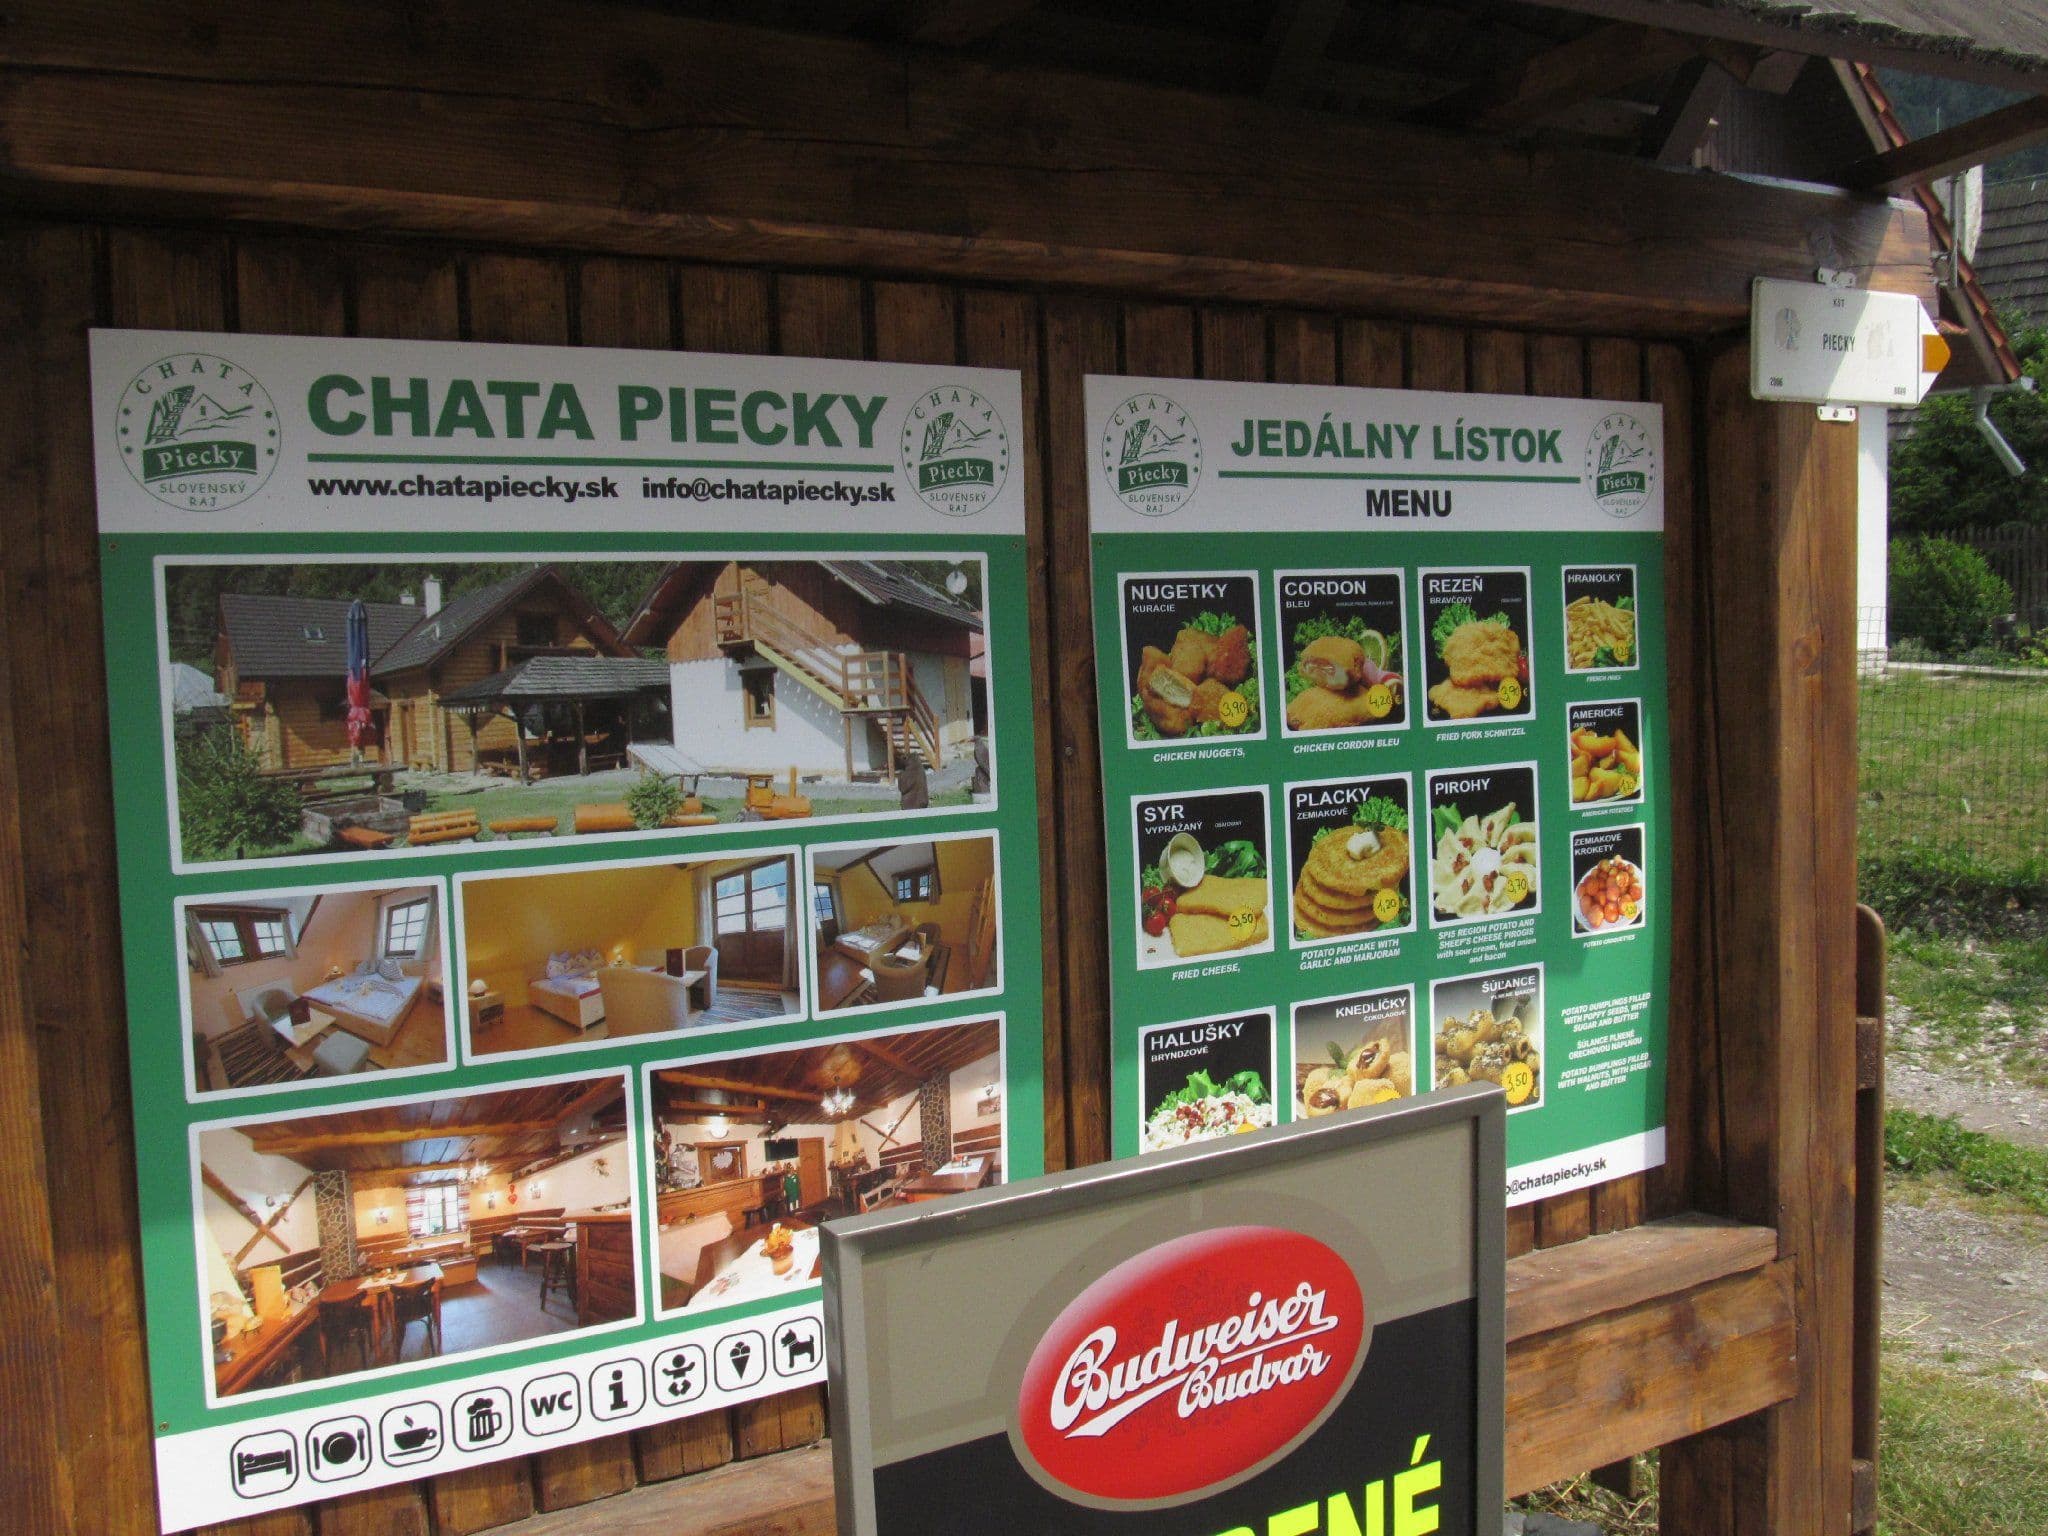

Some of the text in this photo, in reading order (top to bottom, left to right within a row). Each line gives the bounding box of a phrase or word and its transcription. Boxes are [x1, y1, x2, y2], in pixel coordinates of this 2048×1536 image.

[1822, 333, 1855, 351] PIECKY
[135, 356, 254, 398] CHATA
[307, 373, 888, 449] CHATA PIECKY
[914, 389, 993, 422] CHATA
[1114, 398, 1187, 426] CHATA
[1230, 411, 1563, 464] JEDÁLNY LÍSTOK
[157, 444, 245, 472] Piecky
[928, 460, 985, 484] Piecky
[1128, 466, 1180, 488] Piecky
[159, 478, 247, 496] SLOVENSKÝ
[308, 474, 896, 507] www.chatapiecky.sk info@chatapiecky.sk
[1602, 473, 1640, 491] Piecky
[189, 496, 217, 507] RAJ
[929, 490, 988, 502] SLOVENSKÝ
[1366, 488, 1452, 518] MENU
[948, 503, 968, 513] RAJ
[1145, 504, 1164, 514] RAJ
[1429, 575, 1483, 593] REZEŇ
[1567, 573, 1622, 583] HRANOLKY
[1131, 583, 1228, 600] NUGETKY
[1284, 580, 1367, 596] CORDON
[1132, 603, 1176, 613] KURACIE
[1286, 600, 1310, 609] BLEU
[1221, 701, 1246, 718] 3,90
[1437, 727, 1526, 742] FRIED PORK SCHNITZEL
[1293, 738, 1400, 754] CHICKEN CORDON BLEU
[1153, 750, 1197, 763] CHICKEN
[1435, 778, 1491, 795] PIROHY
[1296, 787, 1371, 807] PLACKY
[1144, 804, 1185, 822] SYR
[1297, 807, 1349, 820] ZEMIAKOVÉ
[1145, 821, 1203, 835] VYPRÁŽANÝ
[1574, 844, 1614, 856] KROKETY
[1230, 913, 1253, 928] 3,50
[1458, 926, 1487, 938] REGION
[1488, 921, 1518, 933] POTATO
[1519, 918, 1534, 929] AND
[1472, 933, 1503, 945] CHEESE
[1301, 938, 1399, 961] POTATO PANCAKE WITH
[1437, 949, 1454, 960] with
[1455, 947, 1471, 956] sour
[1499, 940, 1516, 950] fried
[1469, 951, 1507, 964] and bacon
[1300, 948, 1401, 971] GARLIC AND MARJORAM
[1171, 963, 1241, 981] FRIED CHEESE,
[1335, 997, 1407, 1019] KNEDLÍČKY
[1561, 992, 1652, 1017] POTATO DUMPLINGS FILLED
[1564, 1015, 1583, 1025] WITH
[1583, 1011, 1606, 1022] POPPY
[1630, 1000, 1648, 1011] WITH
[1573, 1012, 1640, 1033] SUGAR AND BUTTER
[1151, 1022, 1245, 1051] HALUŠKY
[1151, 1044, 1209, 1062] BRYNDZOVÉ
[1557, 1079, 1576, 1089] WITH
[1611, 1065, 1629, 1076] WITH
[1629, 1059, 1652, 1072] SUGAR
[1561, 1052, 1649, 1080] POTATO DUMPLINGS FILLED
[1507, 1072, 1528, 1093] 3,50
[1585, 1074, 1627, 1092] AND BUTTER
[1049, 1281, 1339, 1432] Budweiser
[1177, 1342, 1331, 1419] Budvar
[531, 1390, 573, 1418] WC
